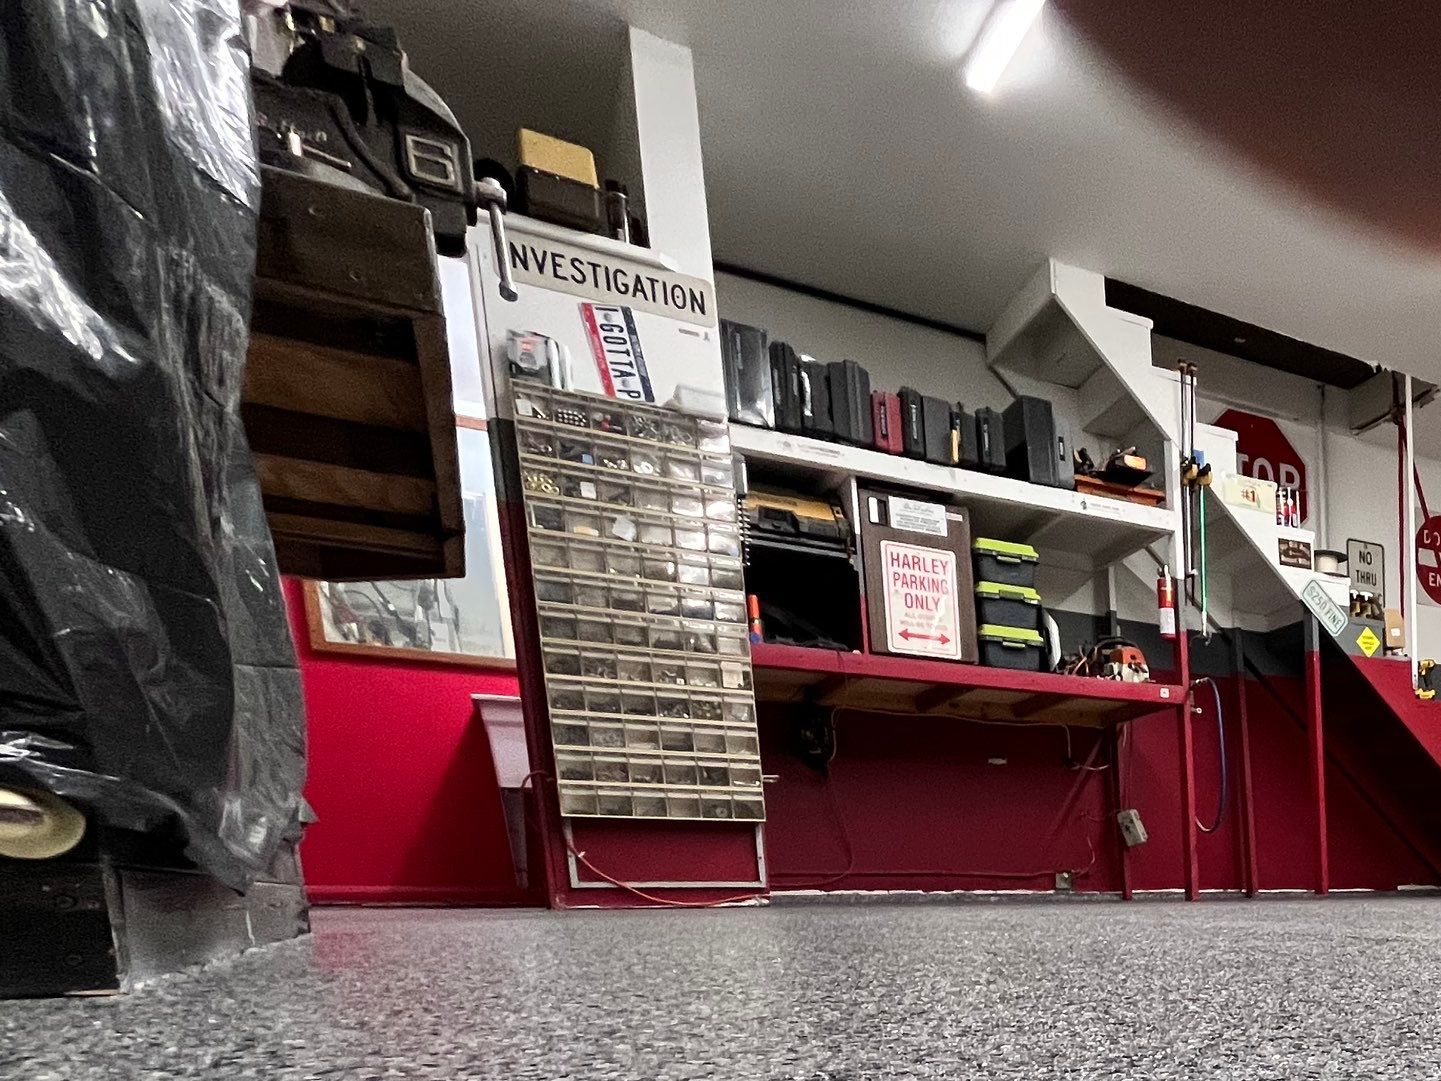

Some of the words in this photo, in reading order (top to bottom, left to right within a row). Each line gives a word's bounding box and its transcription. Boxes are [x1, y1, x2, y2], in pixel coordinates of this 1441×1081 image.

[509, 241, 707, 316] NVESTIGATION
[599, 323, 637, 378] GOTTA
[616, 389, 641, 399] P
[891, 551, 948, 575] HARLEY
[1359, 551, 1373, 565] NO
[893, 571, 949, 595] PARKING
[1355, 569, 1377, 587] THRU
[904, 592, 940, 611] ONLY
